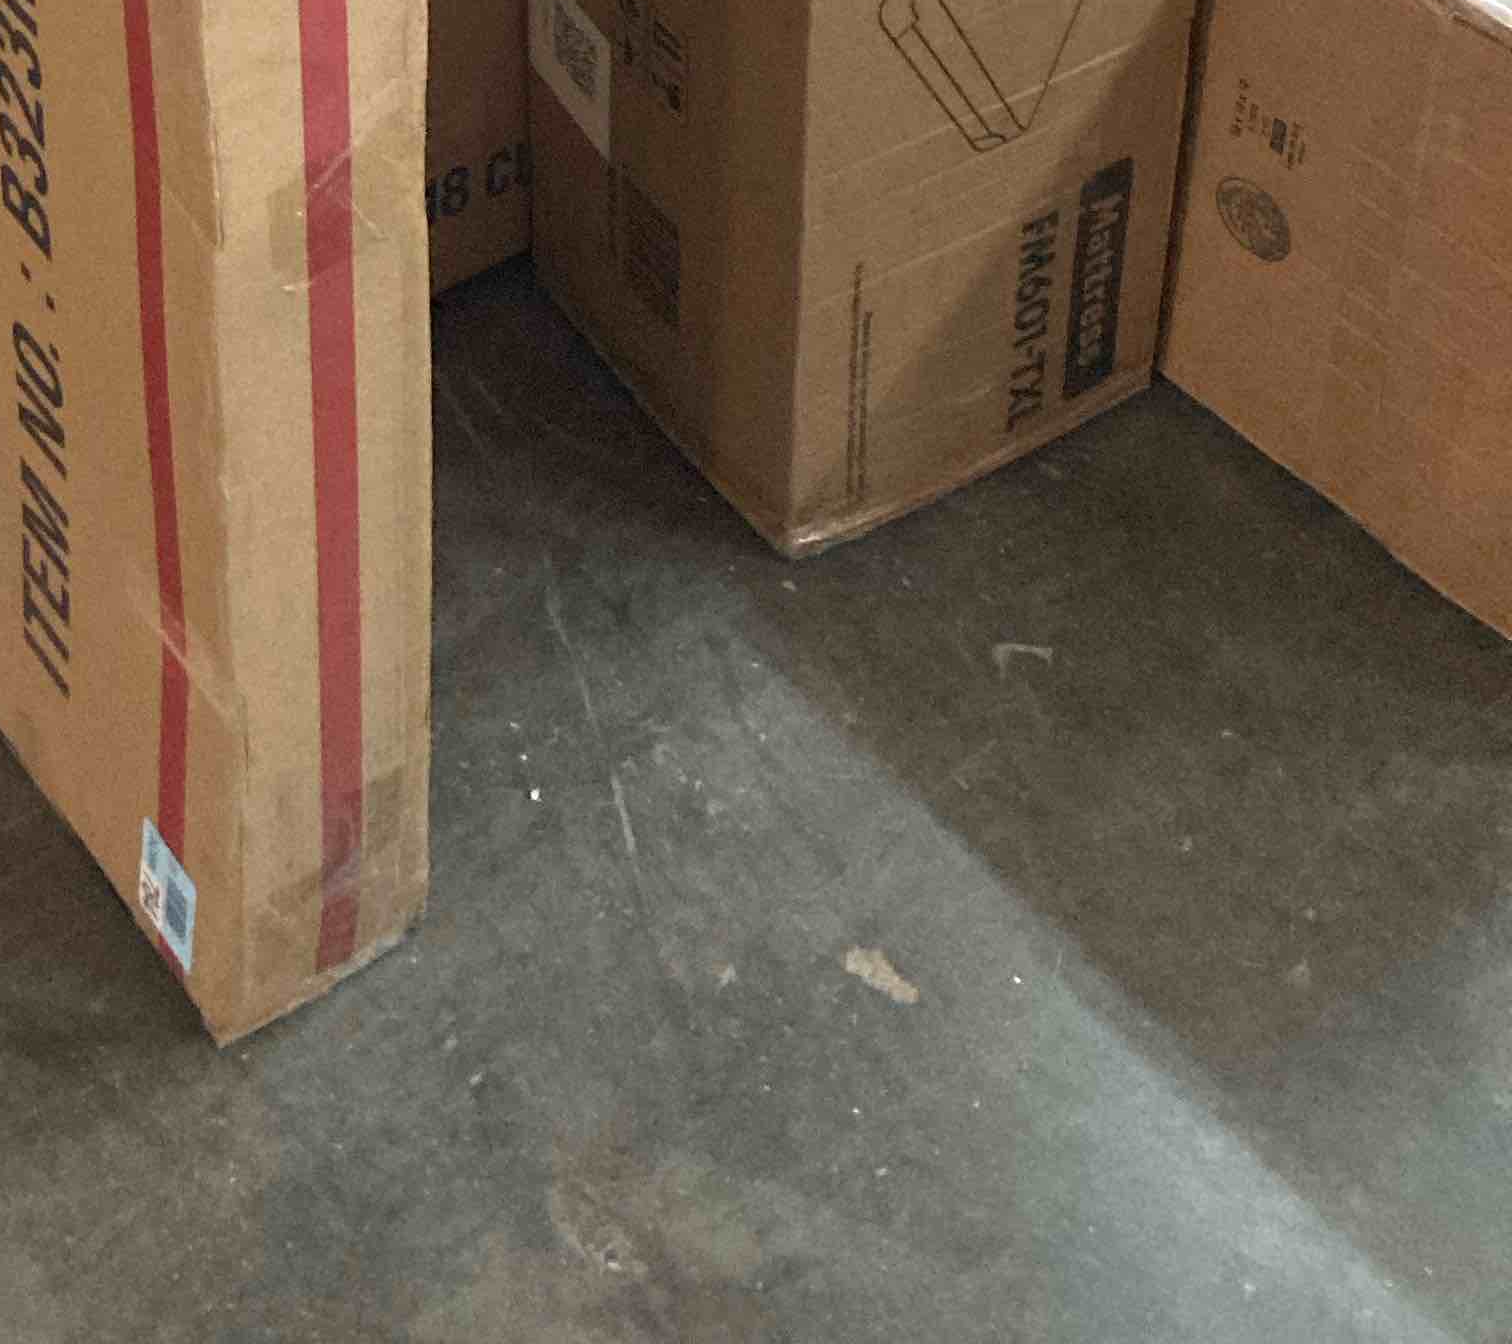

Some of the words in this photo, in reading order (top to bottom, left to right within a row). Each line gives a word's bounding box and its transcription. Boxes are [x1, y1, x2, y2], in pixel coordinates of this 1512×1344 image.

[12, 320, 68, 480] NO.
[1006, 210, 1060, 434] FM601-TXL
[19, 455, 71, 700] ITEM
